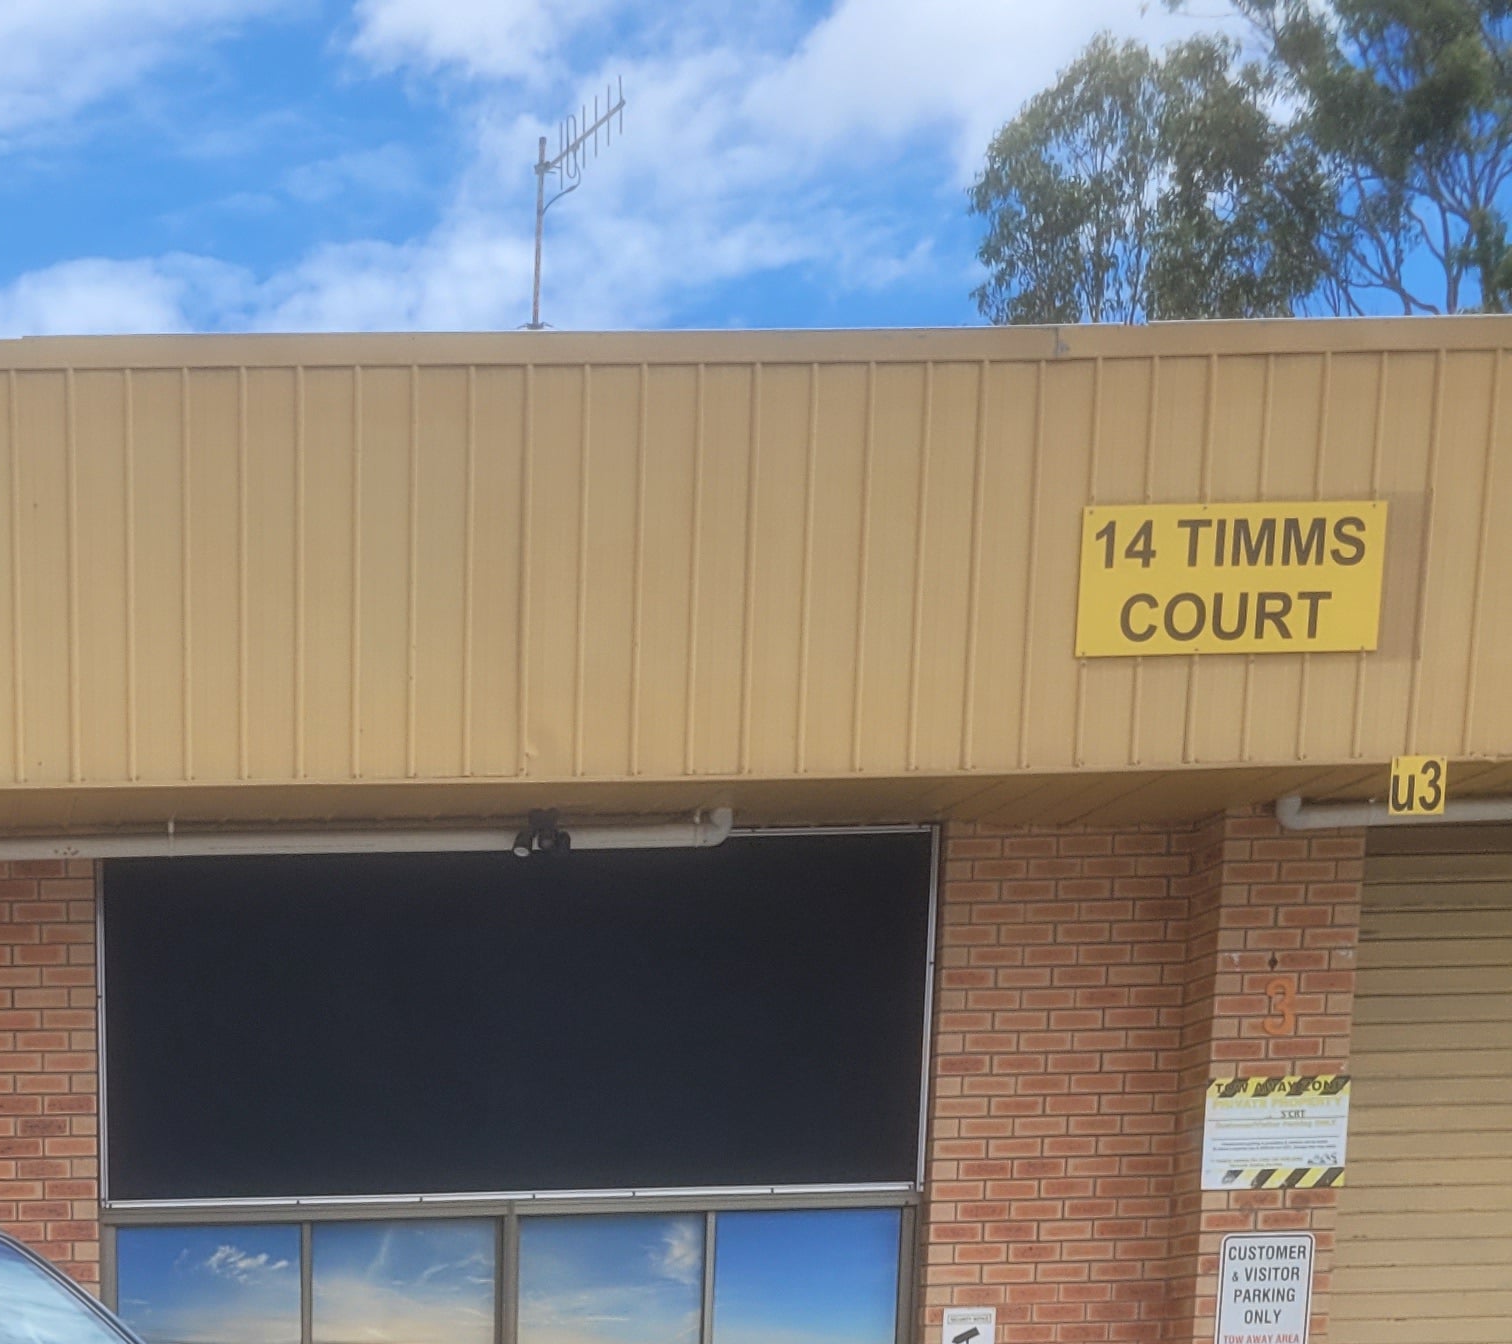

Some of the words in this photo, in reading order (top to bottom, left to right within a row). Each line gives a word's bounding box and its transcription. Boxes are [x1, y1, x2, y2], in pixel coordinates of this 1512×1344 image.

[1095, 519, 1157, 569] 14
[1177, 516, 1367, 567] TIMMS
[1119, 591, 1333, 643] COURT
[1391, 760, 1442, 812] u3
[1263, 978, 1296, 1035] 3
[1228, 1245, 1307, 1261] CUSTOMER
[1231, 1271, 1239, 1282] &
[1244, 1267, 1300, 1281] VISITOR
[1233, 1288, 1296, 1303] PARKING
[1244, 1309, 1282, 1324] ONLY
[1223, 1335, 1244, 1344] TOW
[1246, 1334, 1273, 1344] AWAY
[1275, 1333, 1300, 1344] AREA
